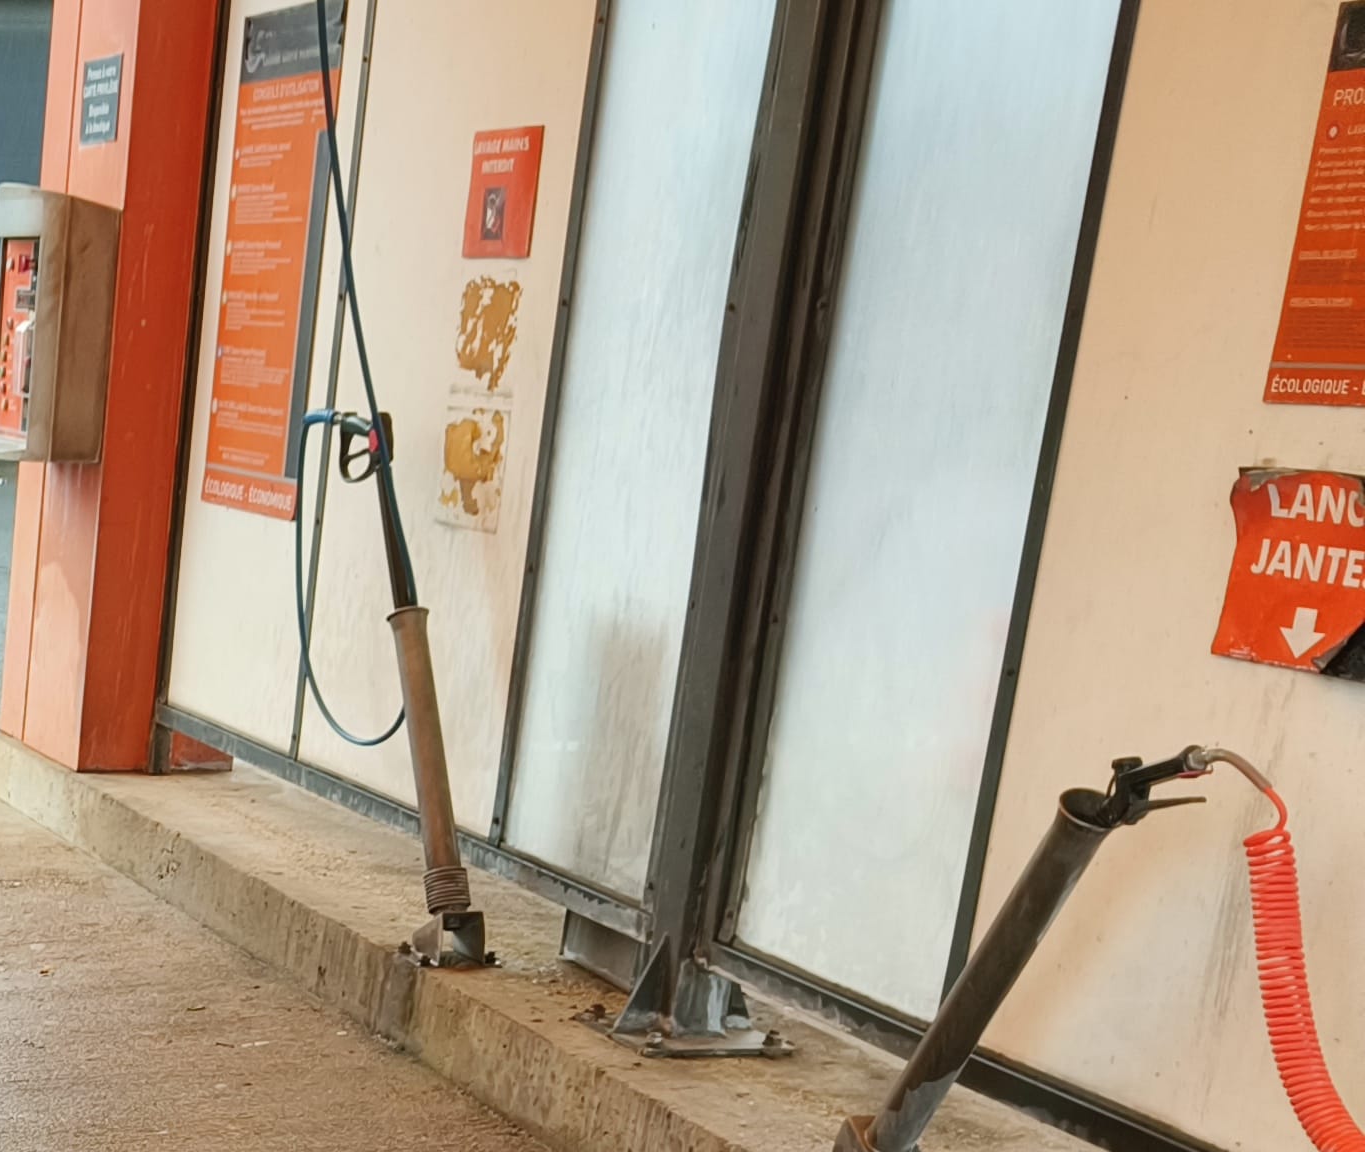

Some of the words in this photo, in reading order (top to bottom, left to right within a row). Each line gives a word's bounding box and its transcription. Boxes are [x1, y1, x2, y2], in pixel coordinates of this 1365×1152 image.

[1333, 86, 1365, 107] PRO
[1271, 374, 1350, 395] ÉCOLOGIQUE
[205, 474, 244, 501] ÉCOLOGIQUE
[249, 483, 292, 511] ÉCONOMIQUE
[1250, 538, 1365, 589] JANTE
